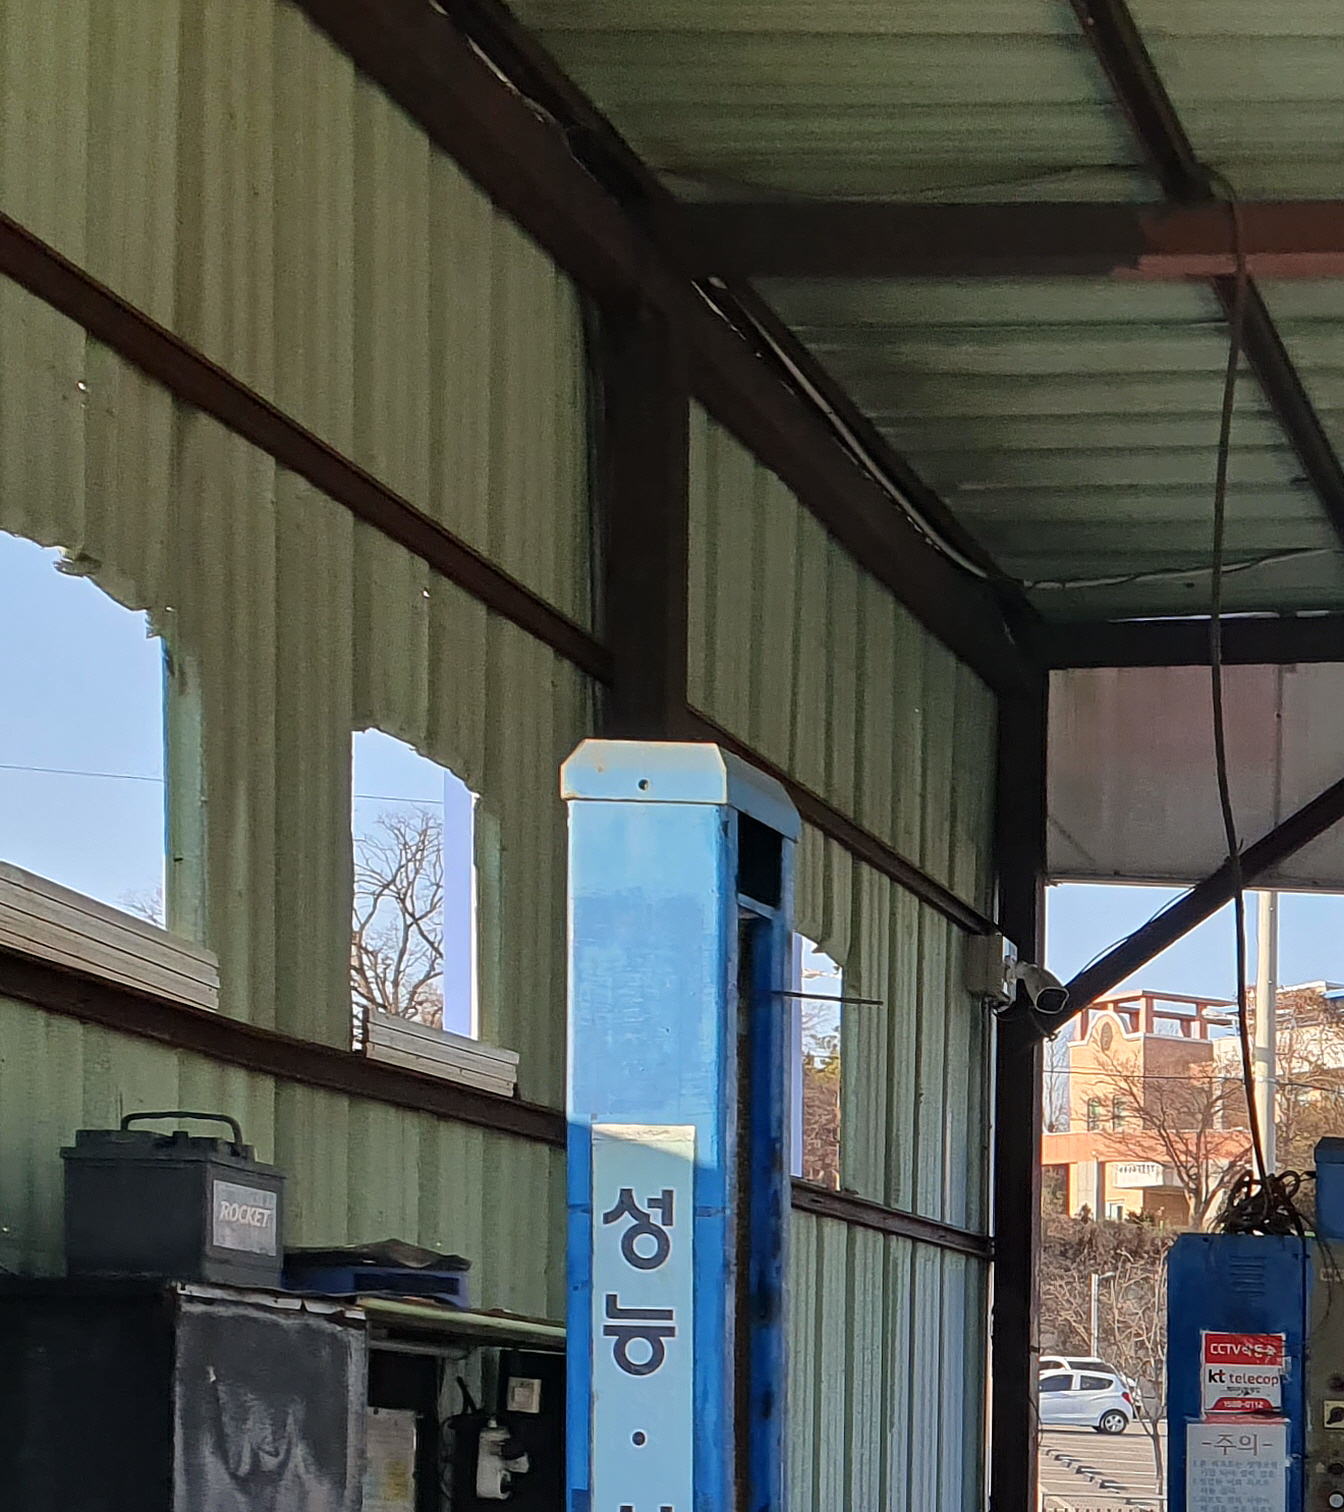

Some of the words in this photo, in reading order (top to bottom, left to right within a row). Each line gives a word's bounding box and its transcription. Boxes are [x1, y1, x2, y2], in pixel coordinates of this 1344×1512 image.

[220, 1200, 271, 1229] ROCKET
[1208, 1368, 1226, 1384] kt
[1229, 1373, 1279, 1387] telecop
